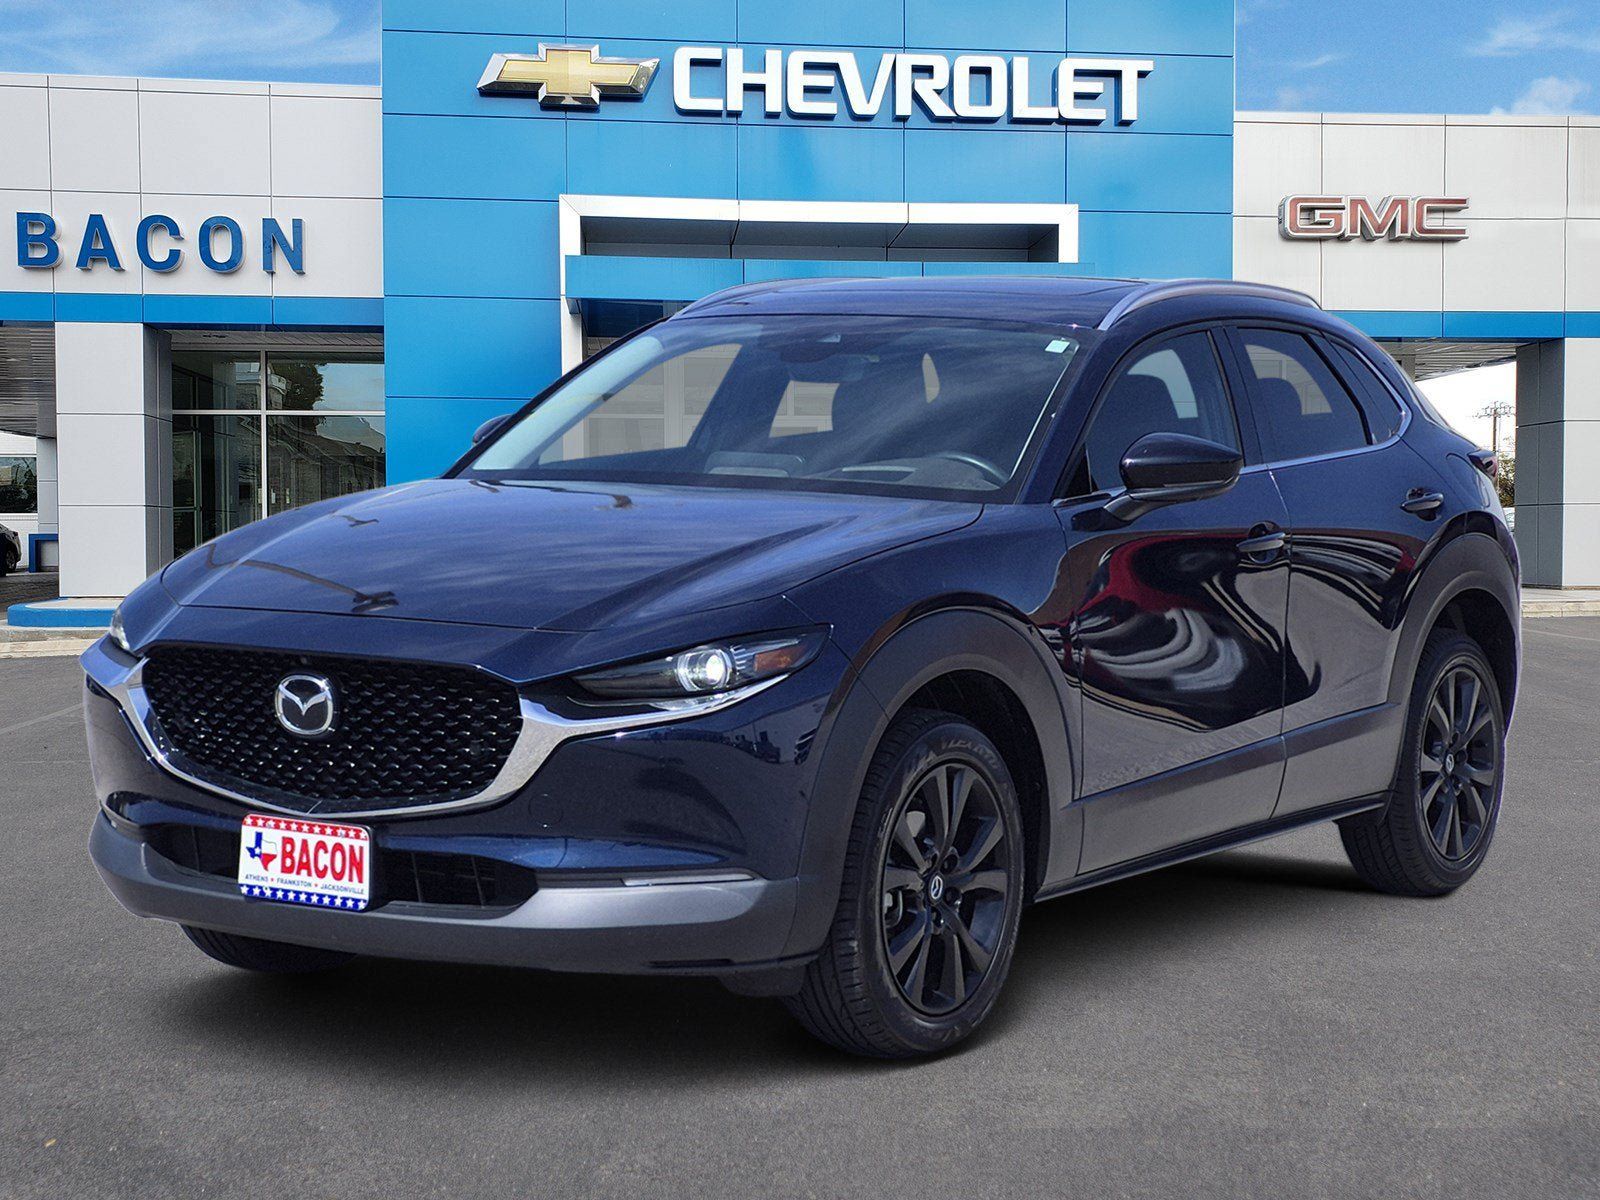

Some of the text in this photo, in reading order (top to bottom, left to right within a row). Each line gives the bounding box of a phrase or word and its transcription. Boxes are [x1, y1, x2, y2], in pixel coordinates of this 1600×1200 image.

[672, 46, 1154, 124] CHEVROLET
[1279, 194, 1471, 241] GMC
[16, 211, 305, 274] BACON
[280, 836, 364, 884] BACON
[245, 874, 364, 895] ATHENS FRANKSTON JACKSONVILLE
